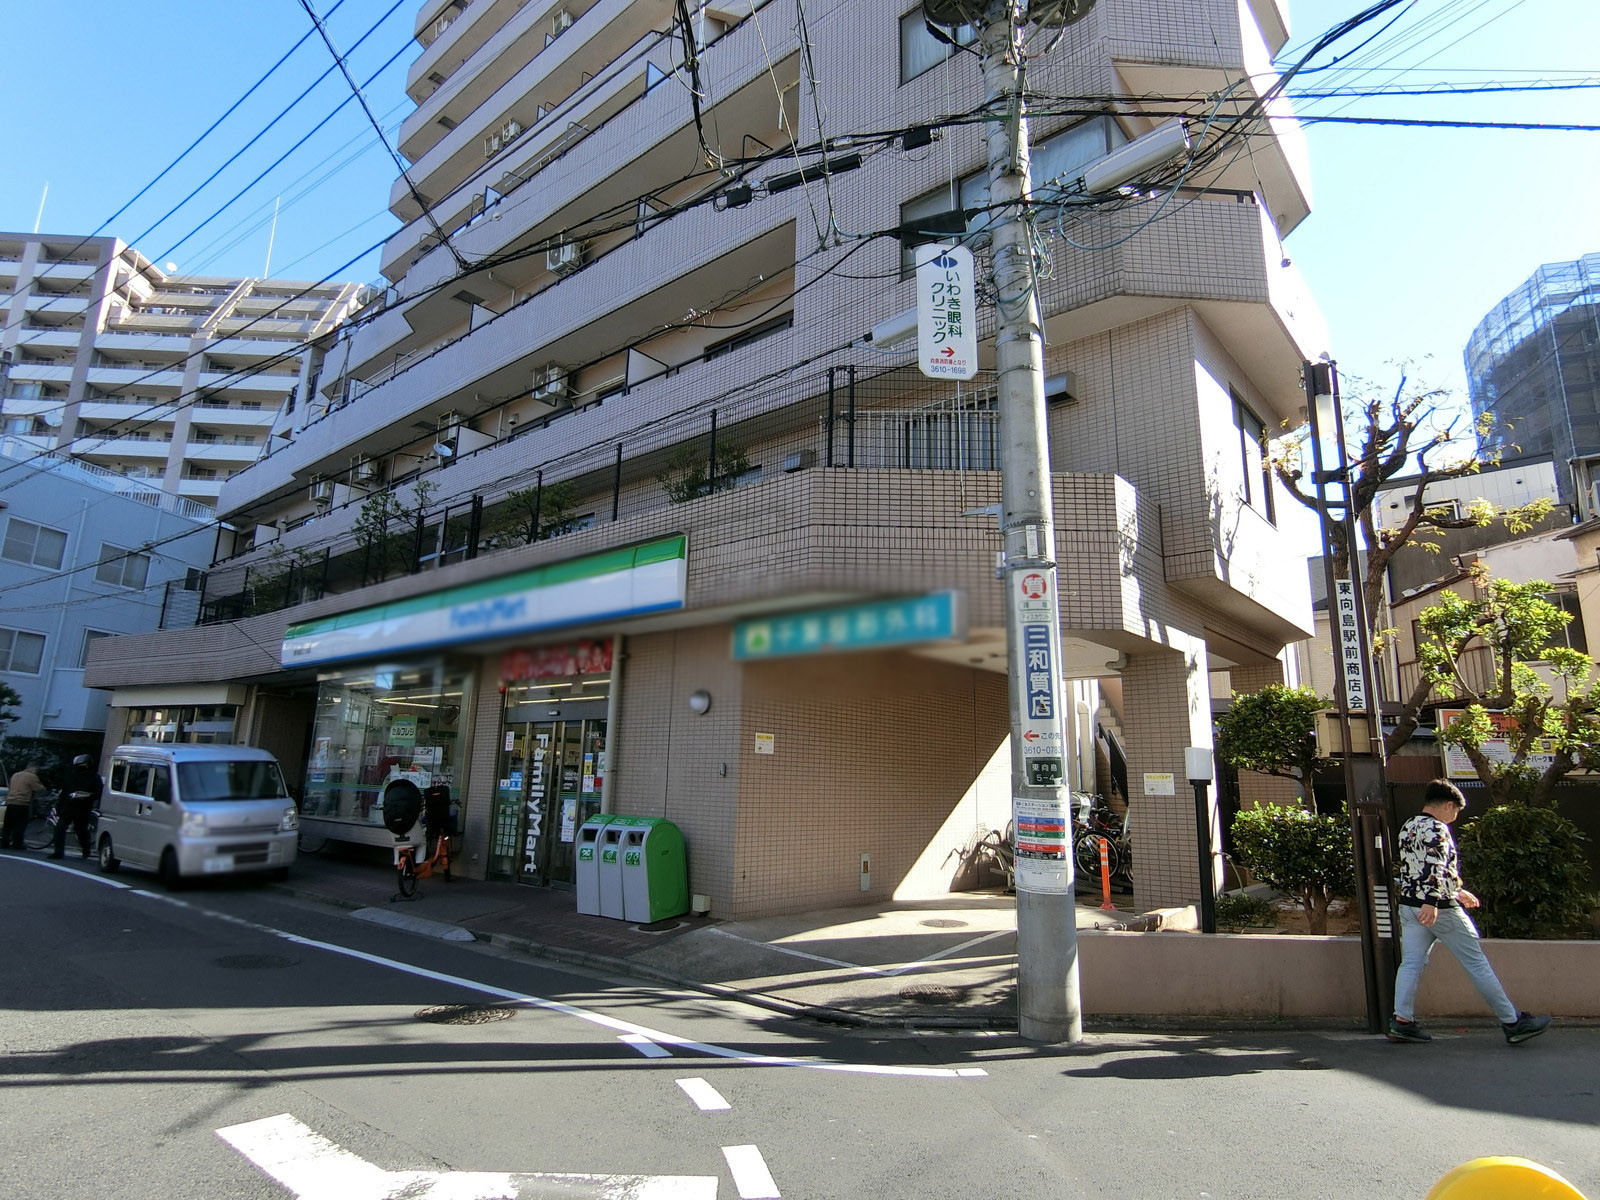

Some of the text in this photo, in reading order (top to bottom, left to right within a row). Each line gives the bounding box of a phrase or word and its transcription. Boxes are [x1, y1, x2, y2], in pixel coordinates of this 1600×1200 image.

[931, 282, 947, 344] クリニック
[945, 270, 963, 338] いわき眼科
[930, 365, 967, 375] 3610-1698
[1027, 627, 1051, 718] 三和質店
[1337, 582, 1364, 709] 東向島駅前商店会
[392, 726, 415, 736] セルフレジ
[1040, 732, 1062, 740] この先
[1031, 763, 1058, 772] 東向島
[523, 733, 549, 873] FamilyMart
